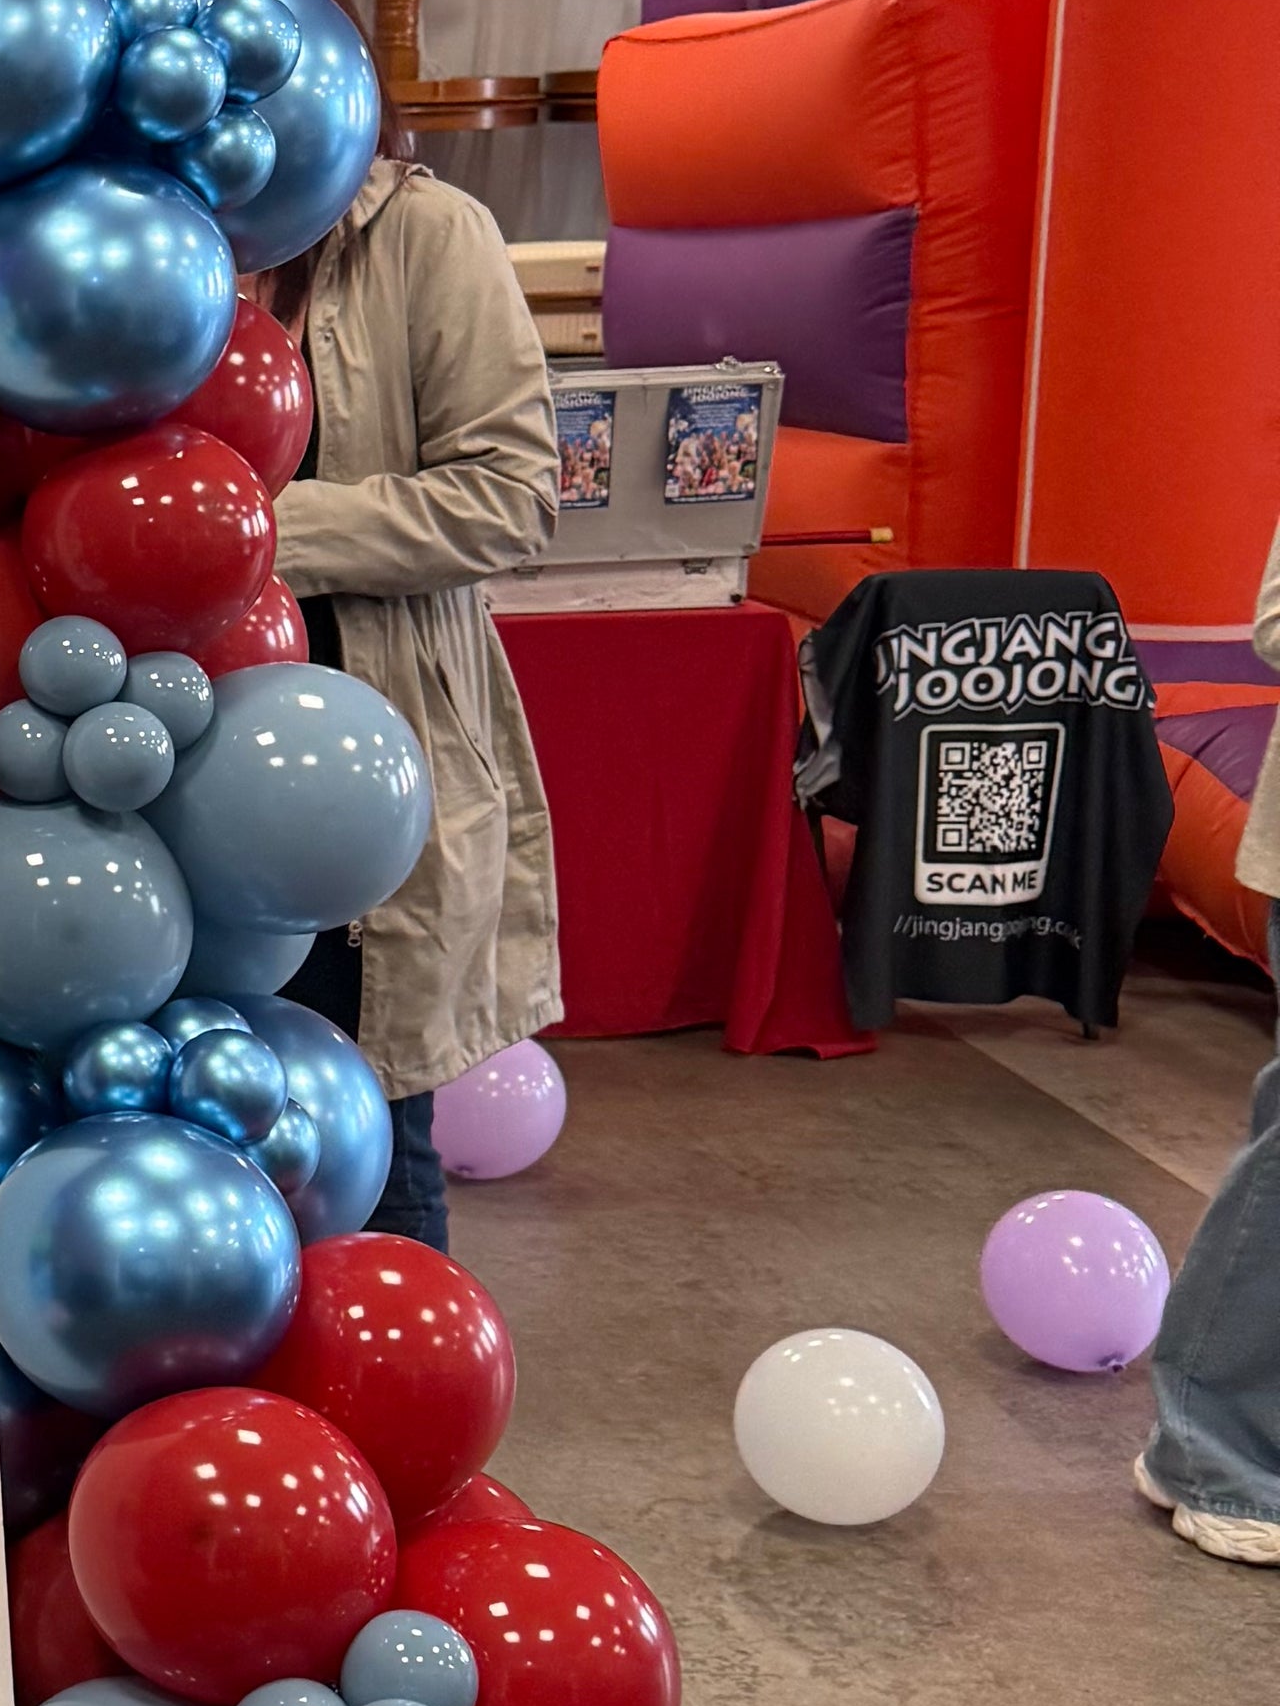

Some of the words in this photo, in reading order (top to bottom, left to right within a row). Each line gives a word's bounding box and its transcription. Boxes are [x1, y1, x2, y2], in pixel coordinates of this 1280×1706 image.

[892, 657, 1139, 713] JOOJONG
[925, 871, 1007, 895] SCAN
[1011, 868, 1039, 893] ME
